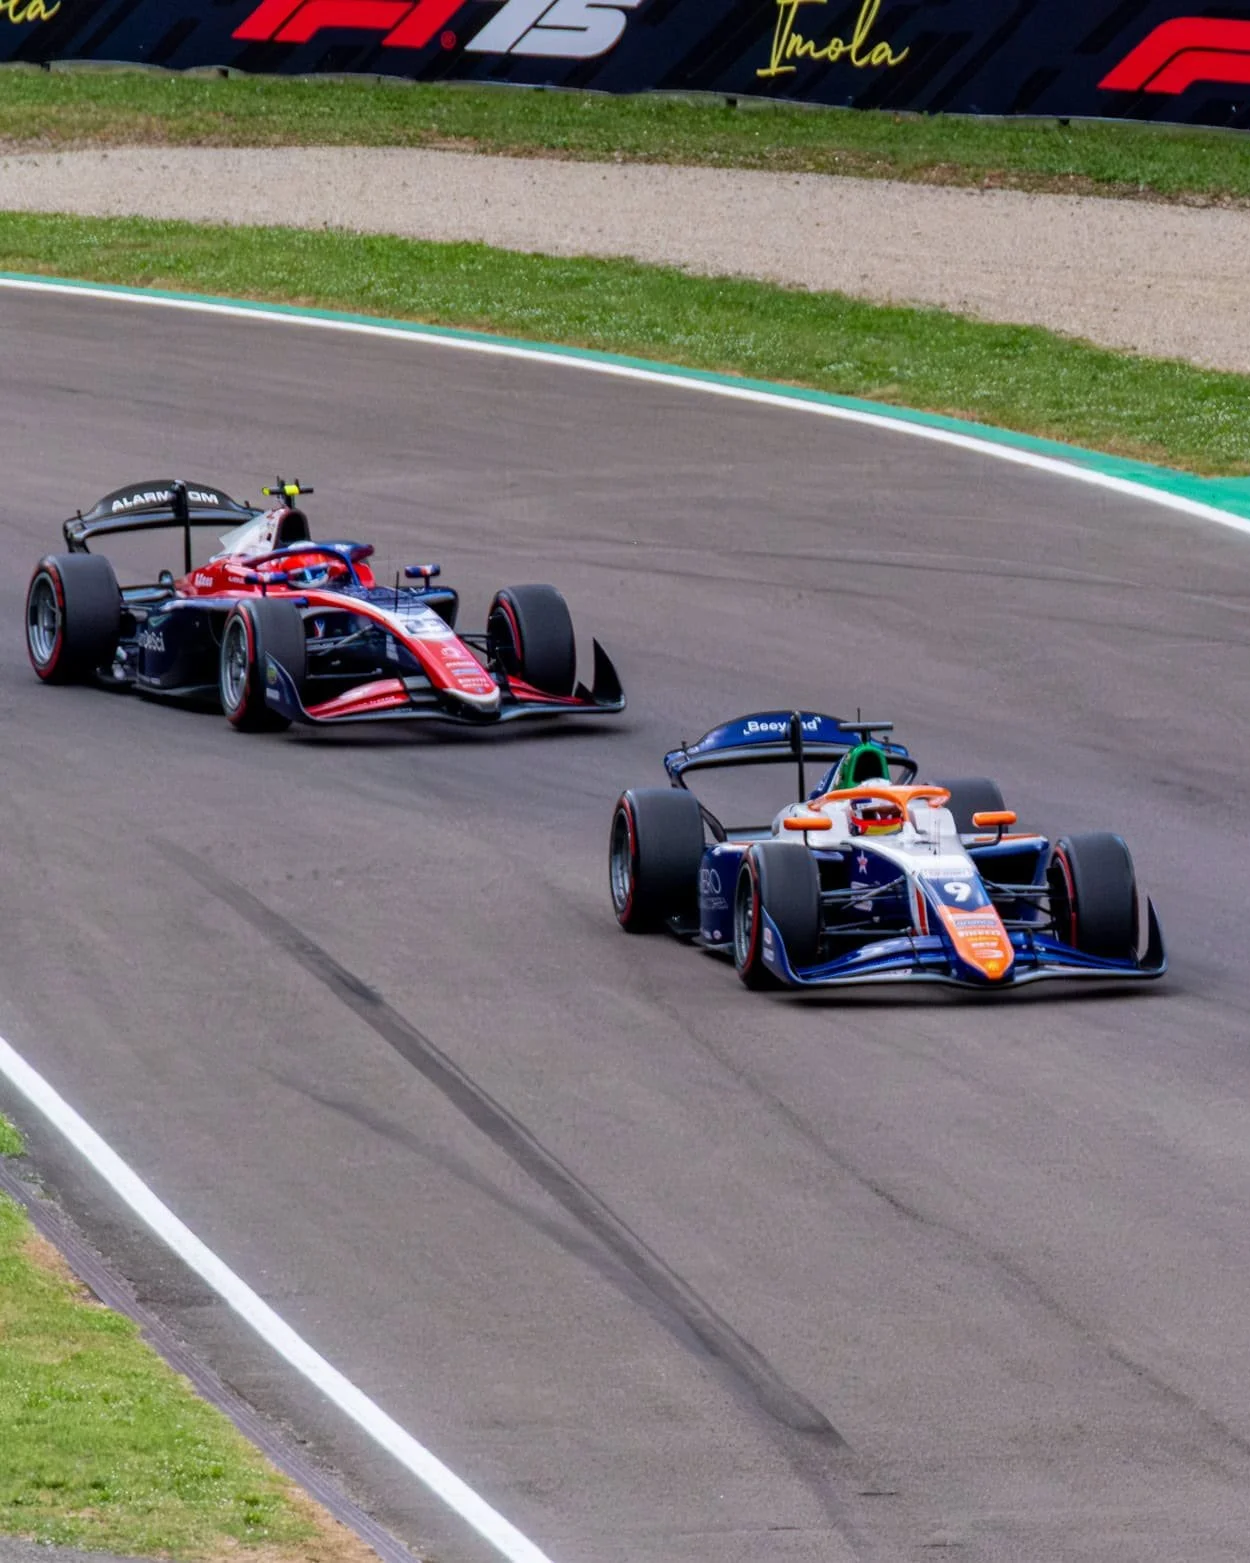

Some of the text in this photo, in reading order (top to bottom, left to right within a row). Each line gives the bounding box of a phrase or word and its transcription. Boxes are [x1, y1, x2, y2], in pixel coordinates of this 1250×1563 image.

[756, 0, 909, 76] Imola
[745, 719, 819, 735] Beeynd
[944, 881, 971, 902] 9
